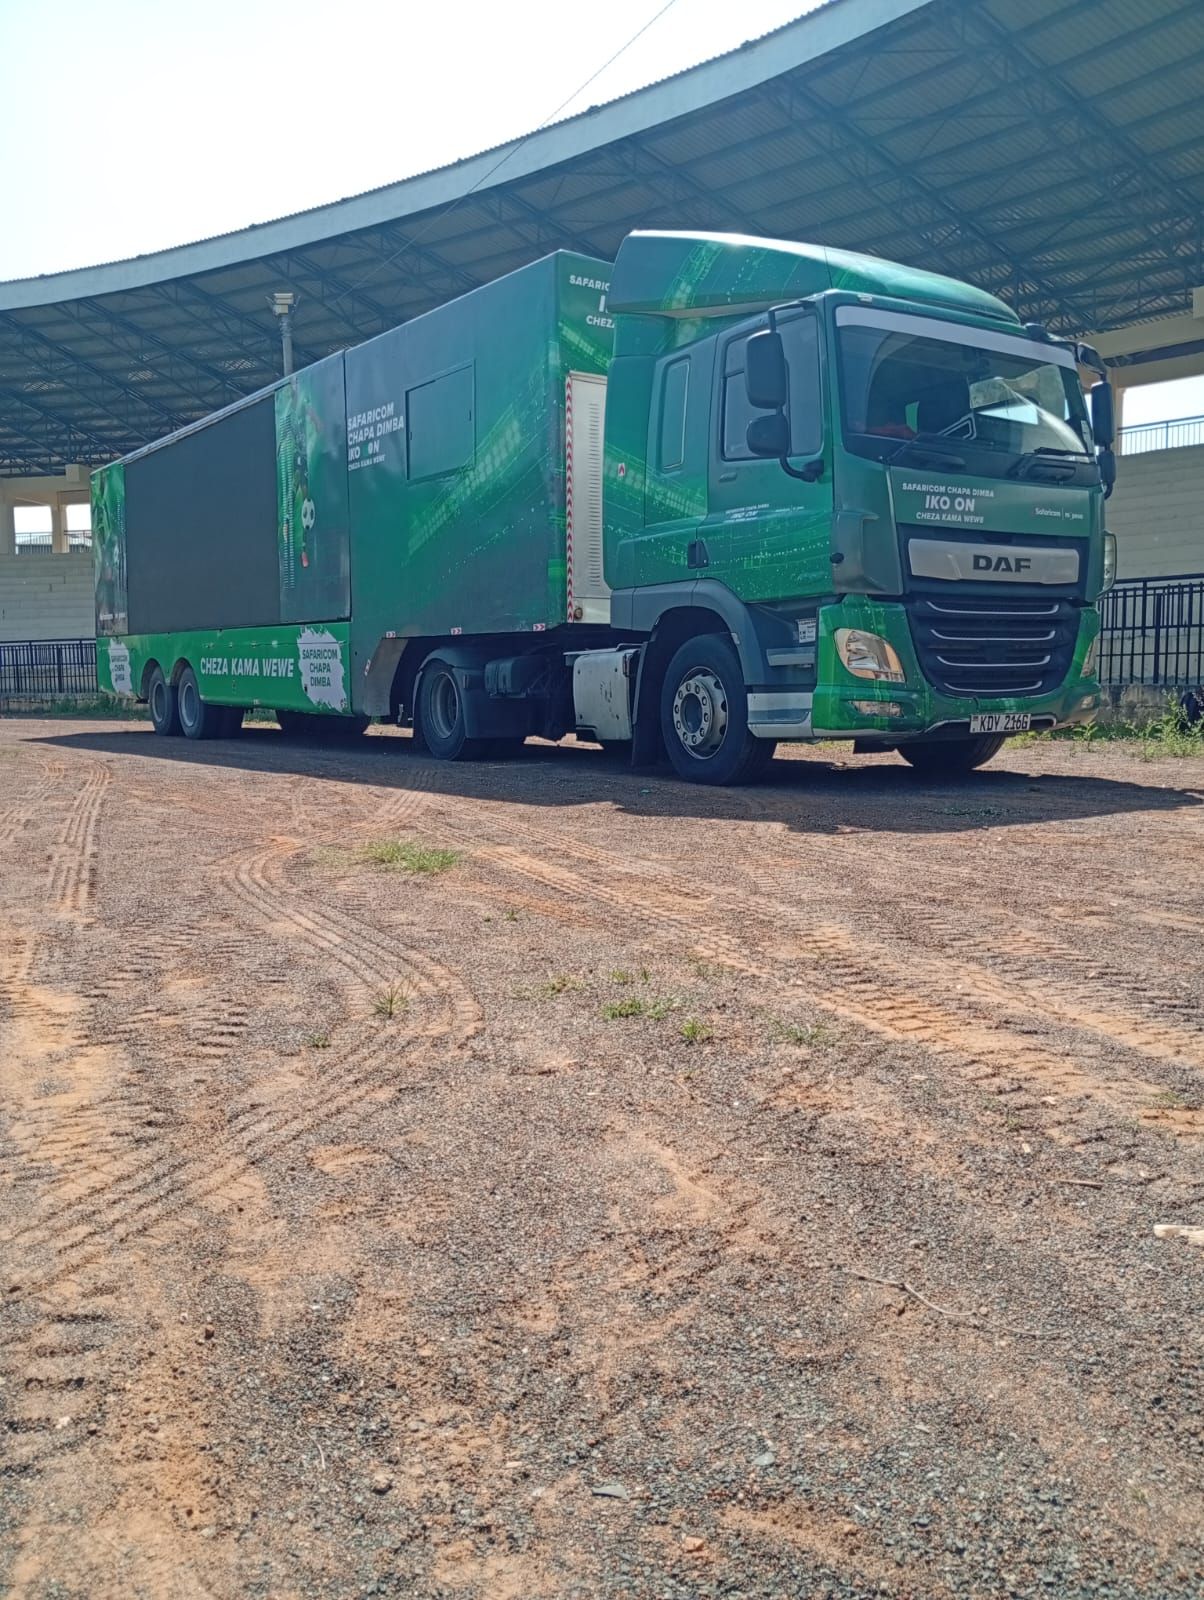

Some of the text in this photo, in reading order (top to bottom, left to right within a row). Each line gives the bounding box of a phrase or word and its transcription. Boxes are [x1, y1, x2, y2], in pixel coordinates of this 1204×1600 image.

[347, 401, 394, 431] SAFARICOM
[347, 416, 404, 445] CHAPA DIMBA
[348, 440, 380, 462] IKO ON
[902, 482, 995, 498] SAFARICOM CHAPA DIMBA
[925, 495, 976, 512] IKO ON
[916, 511, 940, 521] CHEZA
[941, 513, 962, 522] KAMA
[973, 554, 1032, 573] DAF
[302, 648, 338, 660] SAFARICOM
[200, 657, 294, 678] CHEZA KAMA WEWE
[309, 662, 331, 674] CHAPA
[310, 676, 331, 687] DIMBA
[980, 715, 1000, 731] KDY
